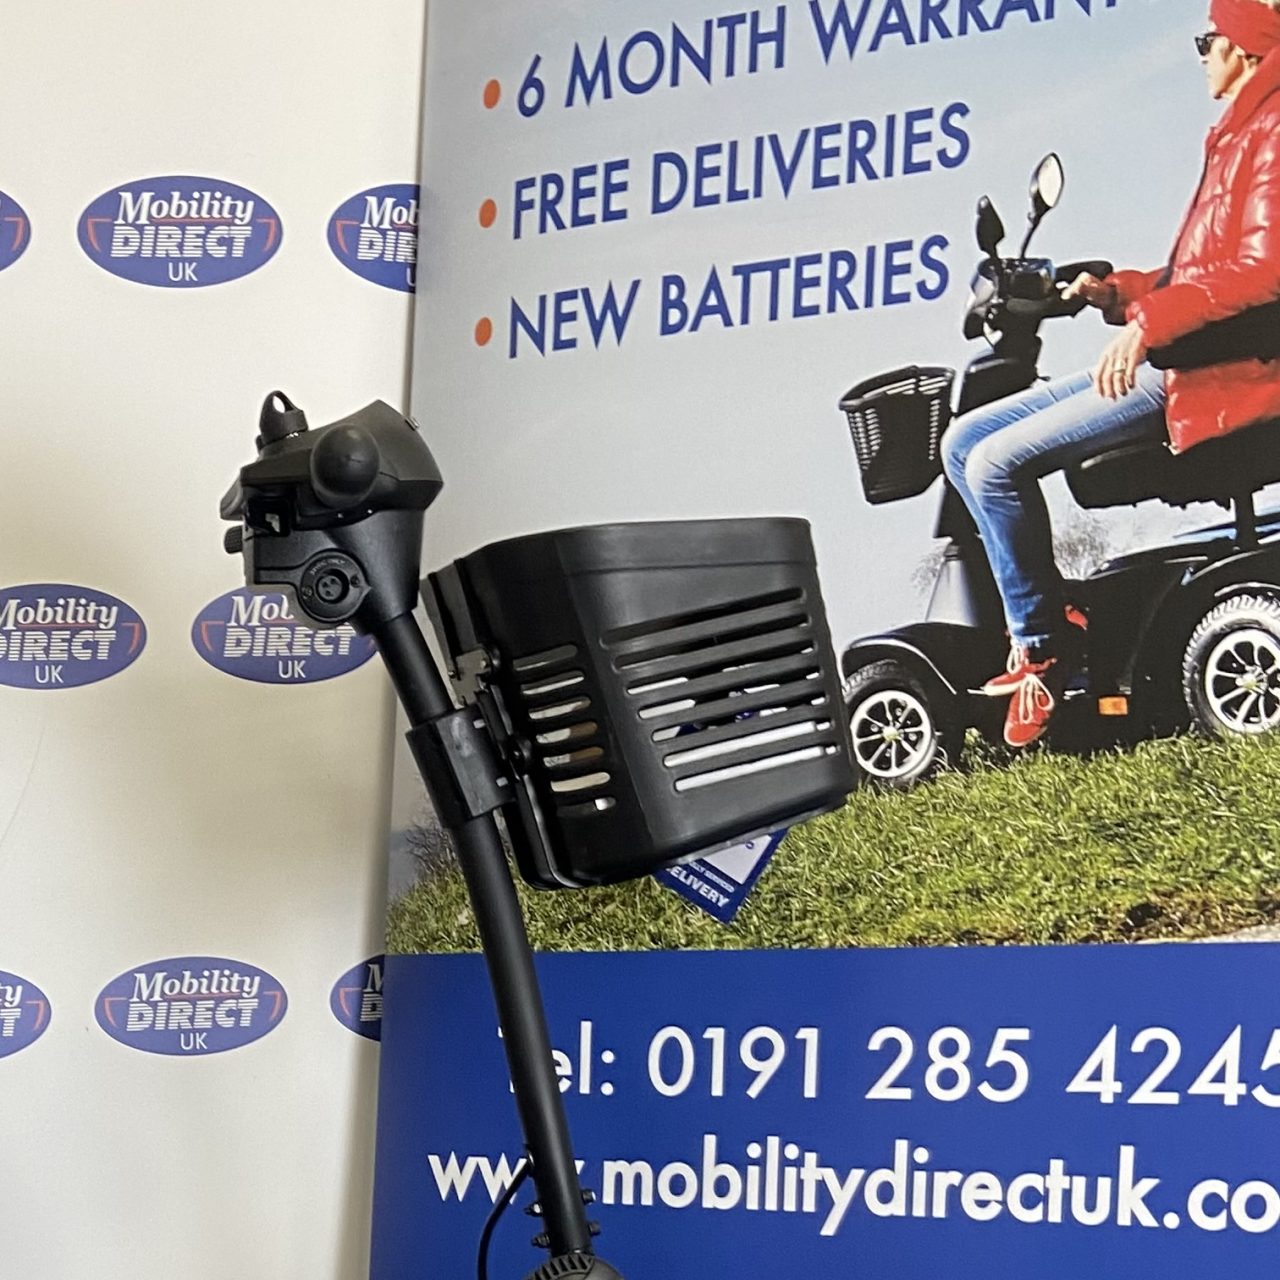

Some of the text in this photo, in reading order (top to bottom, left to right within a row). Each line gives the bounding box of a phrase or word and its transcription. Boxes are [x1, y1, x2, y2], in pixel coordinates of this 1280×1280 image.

[517, 0, 1115, 118] 6 MONTH WARR
[513, 101, 970, 240] FREE DELIVERIES
[115, 192, 254, 224] Mobility
[112, 223, 253, 259] DIRECT
[357, 229, 418, 262] DIR
[168, 261, 198, 282] UK
[508, 234, 950, 359] NEW BATTERIES
[224, 622, 357, 657] DIRECT
[35, 665, 64, 684] UK
[278, 661, 306, 678] UK
[665, 865, 729, 908] ELIVERY
[131, 970, 260, 1000] Mobility
[127, 998, 259, 1031] DIRECT
[180, 1032, 207, 1050] UK
[647, 1025, 819, 1100] 0191
[865, 1025, 1030, 1103] 285
[1065, 1023, 1280, 1108] 4245
[428, 1134, 1280, 1237] wwmobilitydirectuk.co
